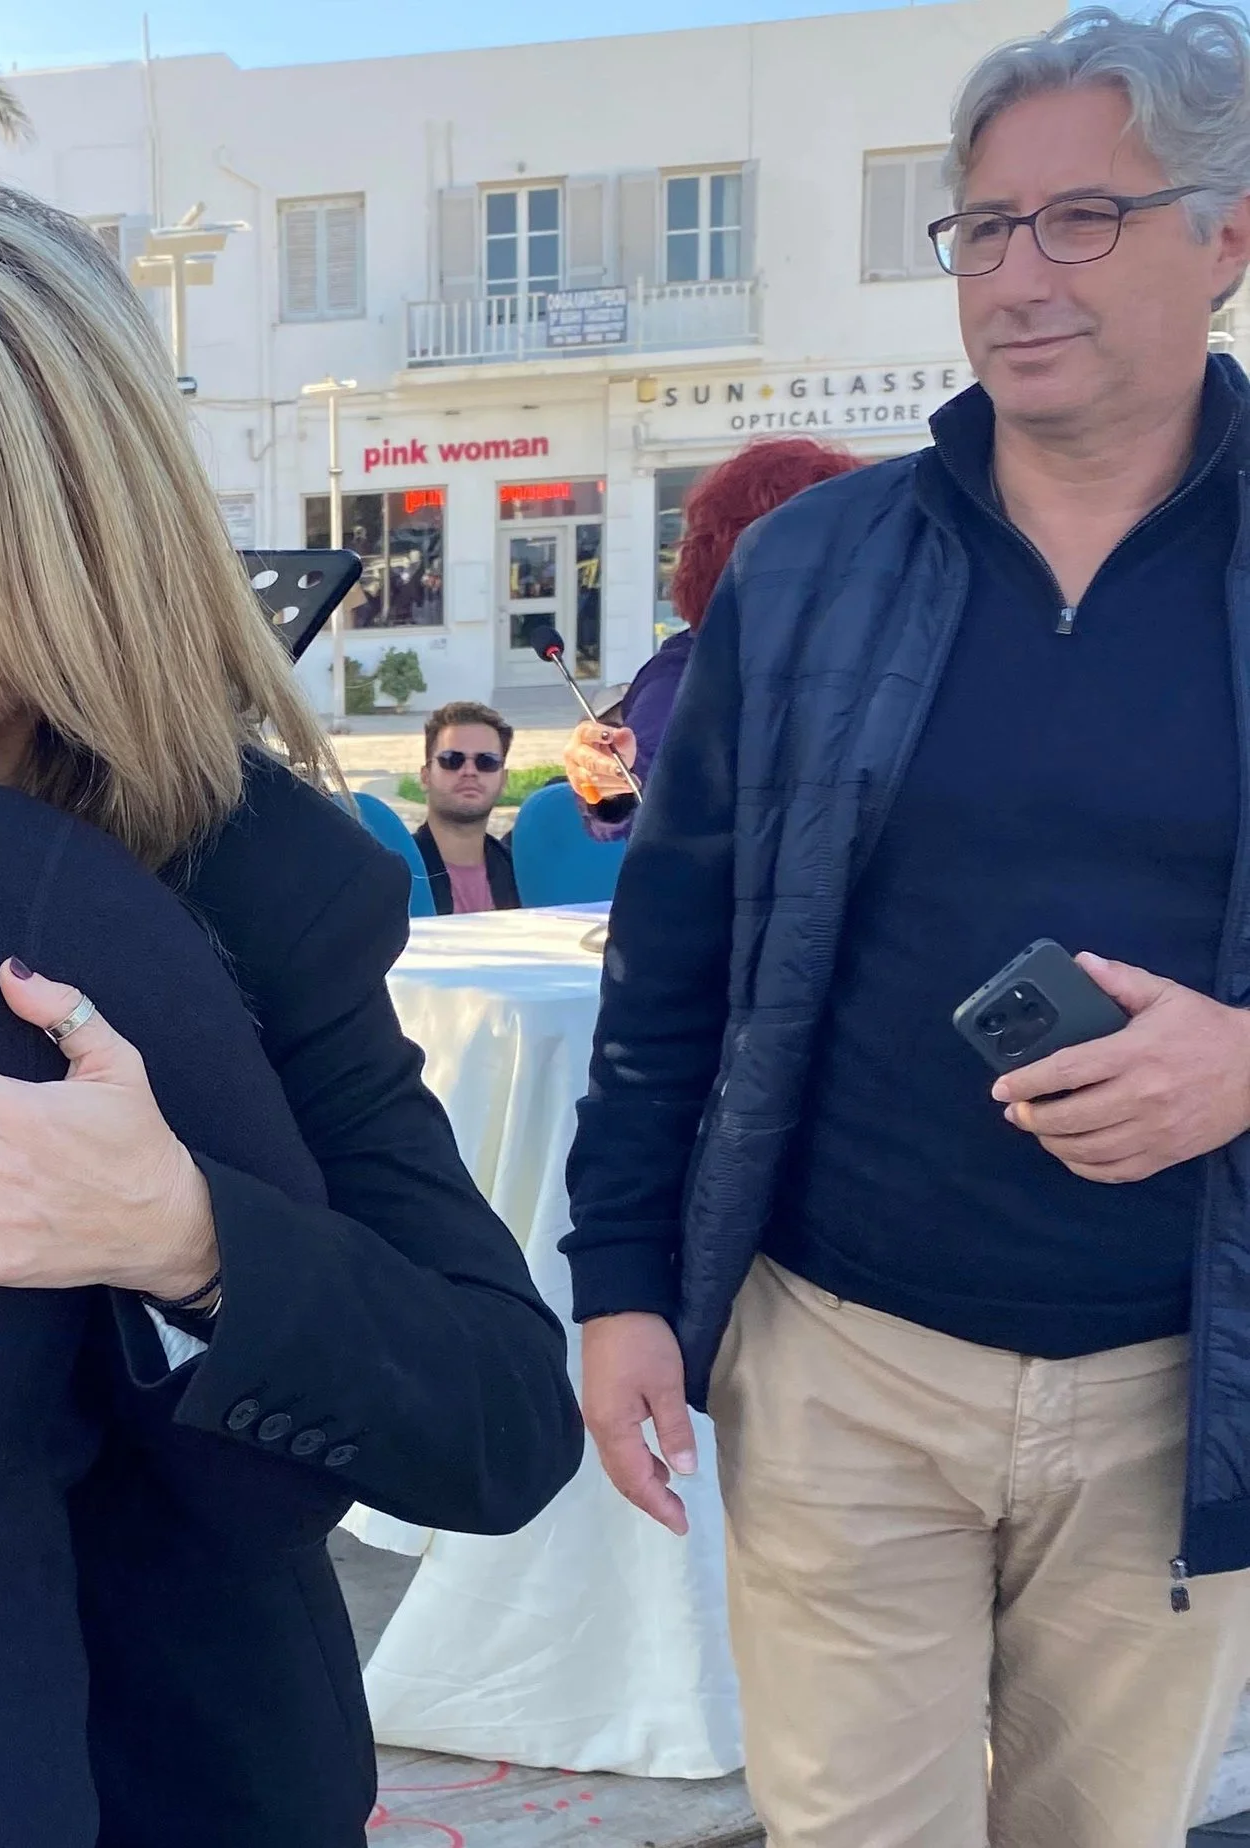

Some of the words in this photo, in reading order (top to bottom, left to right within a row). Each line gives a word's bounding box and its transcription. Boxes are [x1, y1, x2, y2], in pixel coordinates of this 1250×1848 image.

[663, 382, 744, 407] SUN
[789, 369, 978, 399] GLASSE
[730, 409, 833, 431] OPTICAL
[845, 403, 921, 422] STORE
[364, 438, 428, 472] pink
[438, 436, 549, 462] woman
